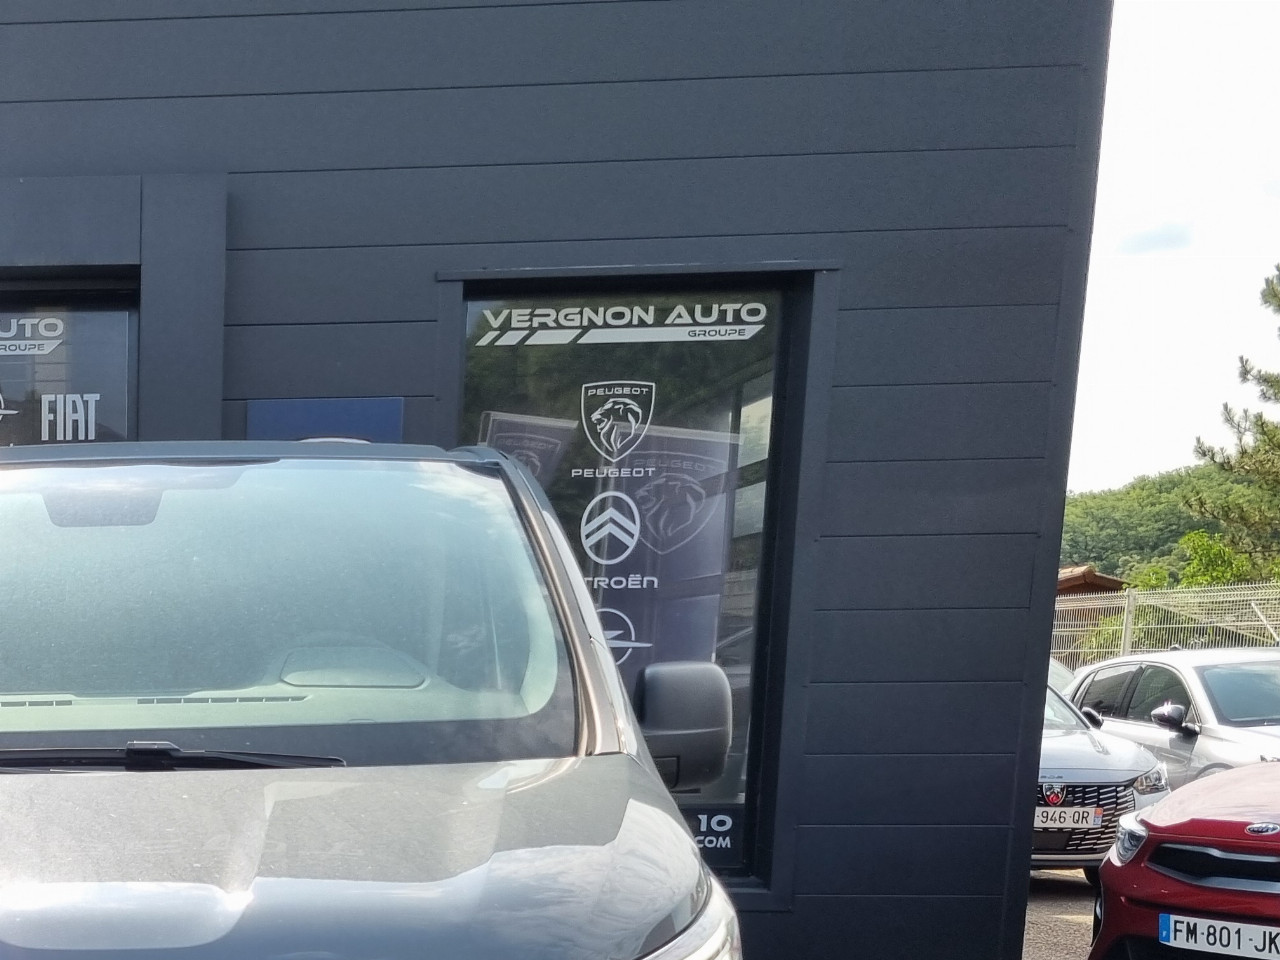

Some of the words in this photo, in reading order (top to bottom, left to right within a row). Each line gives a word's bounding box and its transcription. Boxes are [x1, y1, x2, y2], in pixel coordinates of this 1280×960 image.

[482, 305, 655, 328] VERGNON
[664, 302, 767, 324] AUTO
[687, 328, 746, 338] GROUPE
[588, 387, 649, 396] PEUGEOT
[40, 393, 101, 441] FIAT
[571, 467, 656, 478] PEUGEOT
[697, 814, 733, 832] 10
